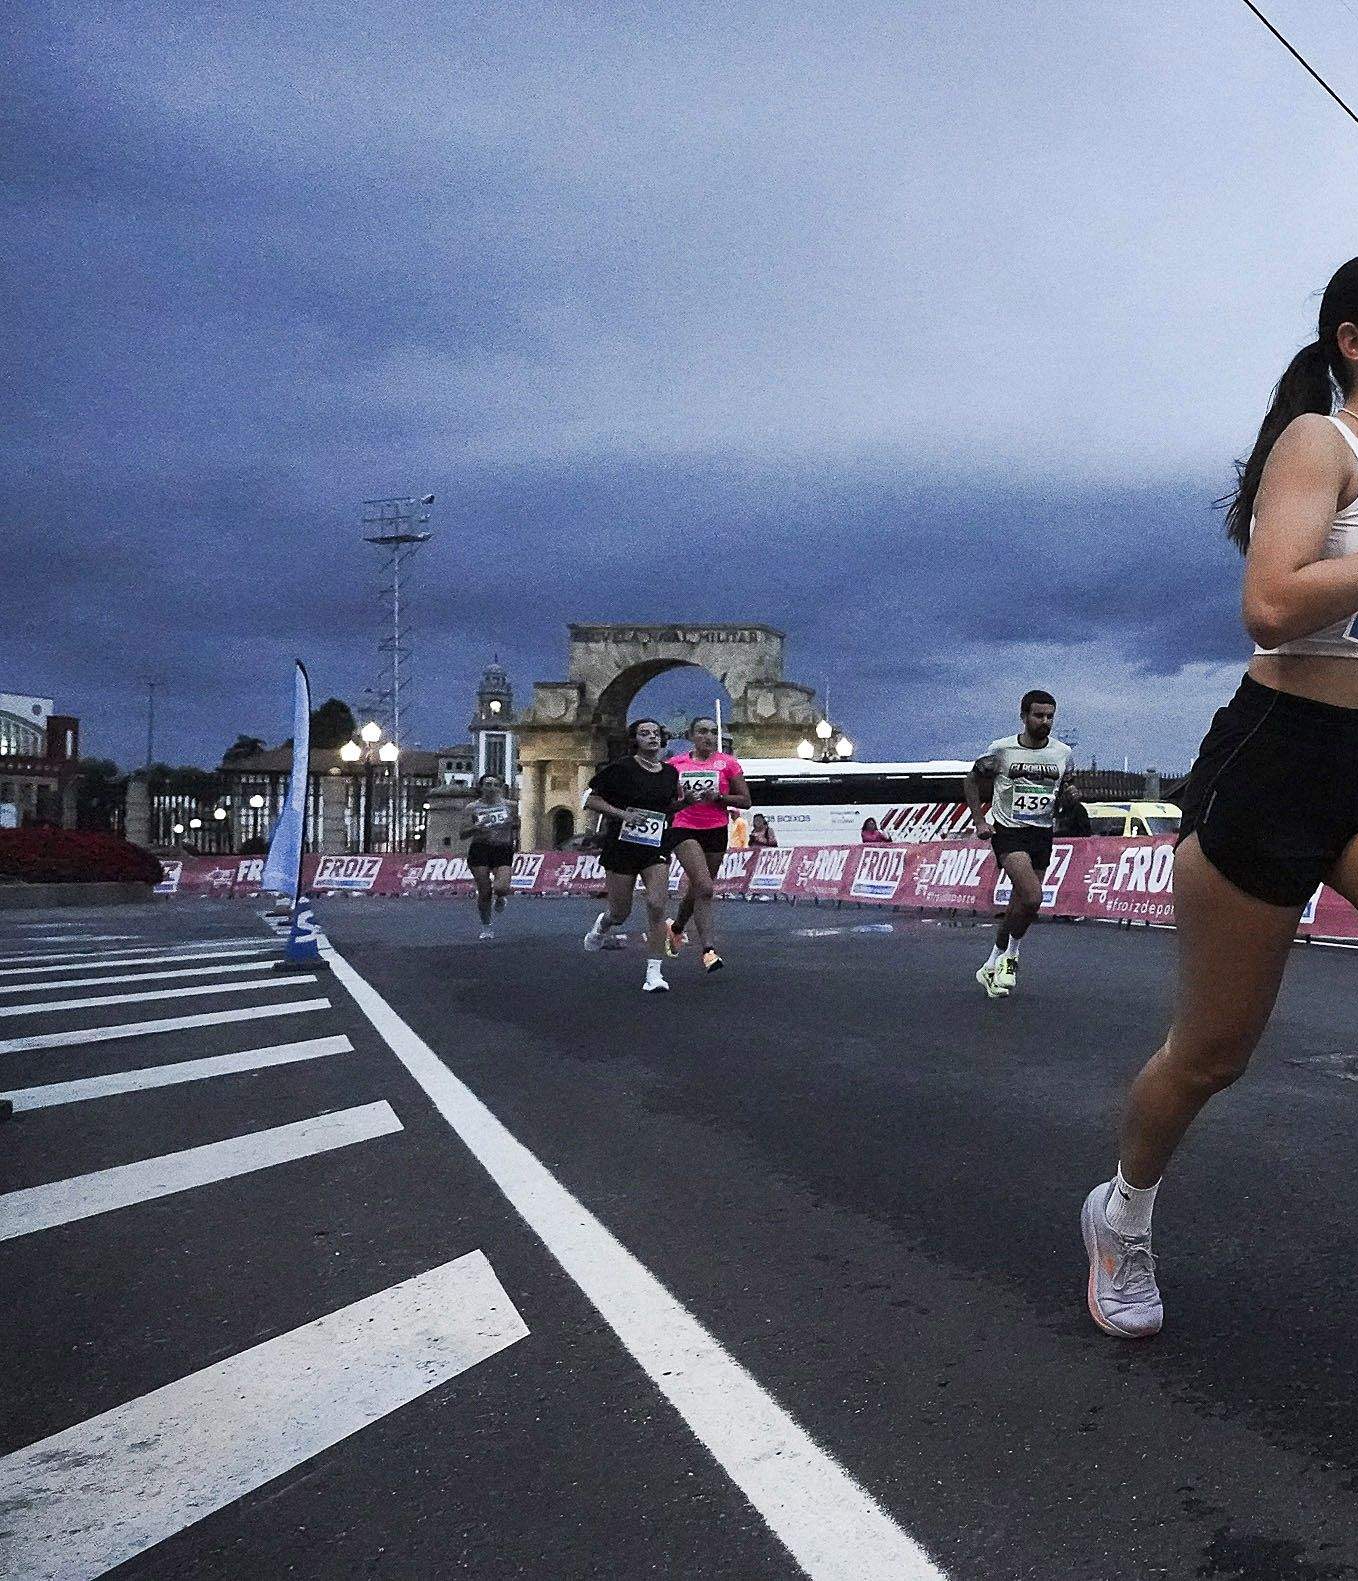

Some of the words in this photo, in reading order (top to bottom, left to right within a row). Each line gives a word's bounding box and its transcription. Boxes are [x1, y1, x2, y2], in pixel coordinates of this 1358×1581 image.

[683, 779, 715, 792] 462
[1014, 796, 1051, 810] 439
[318, 857, 379, 878] FROIZ
[858, 852, 904, 881] FROIZ
[932, 849, 992, 886] FROIZ
[1113, 844, 1175, 893] FRO
